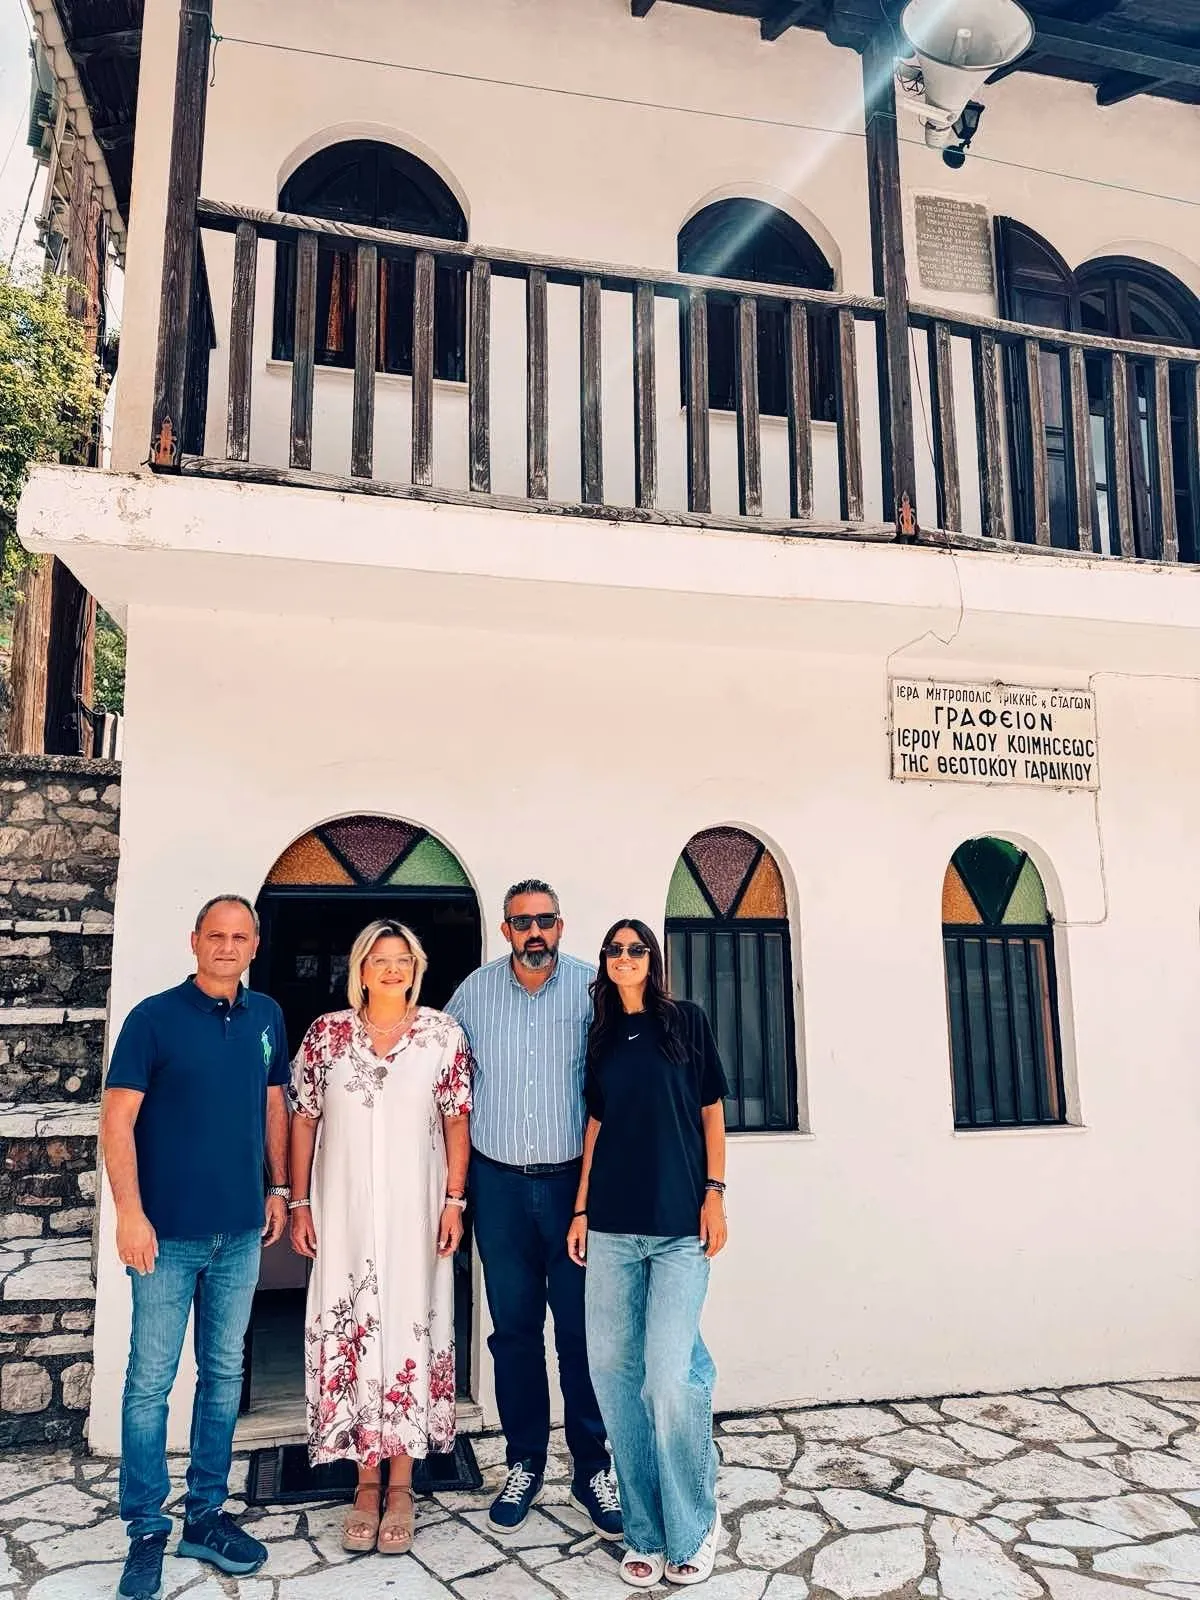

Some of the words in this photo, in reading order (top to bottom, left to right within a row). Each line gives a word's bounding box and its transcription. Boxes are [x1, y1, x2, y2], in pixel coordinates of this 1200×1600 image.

[935, 706, 1053, 732] ΓΡΑΦΕΙΟΝ
[897, 728, 941, 751] ΙΕΡΟΥ
[953, 732, 998, 751] ΝΑΟΥ
[937, 756, 1017, 777] ΘΕΟΤΟΚΟΥ
[1024, 760, 1092, 783] ΓΑΡΔΙΚΙΟΥ
